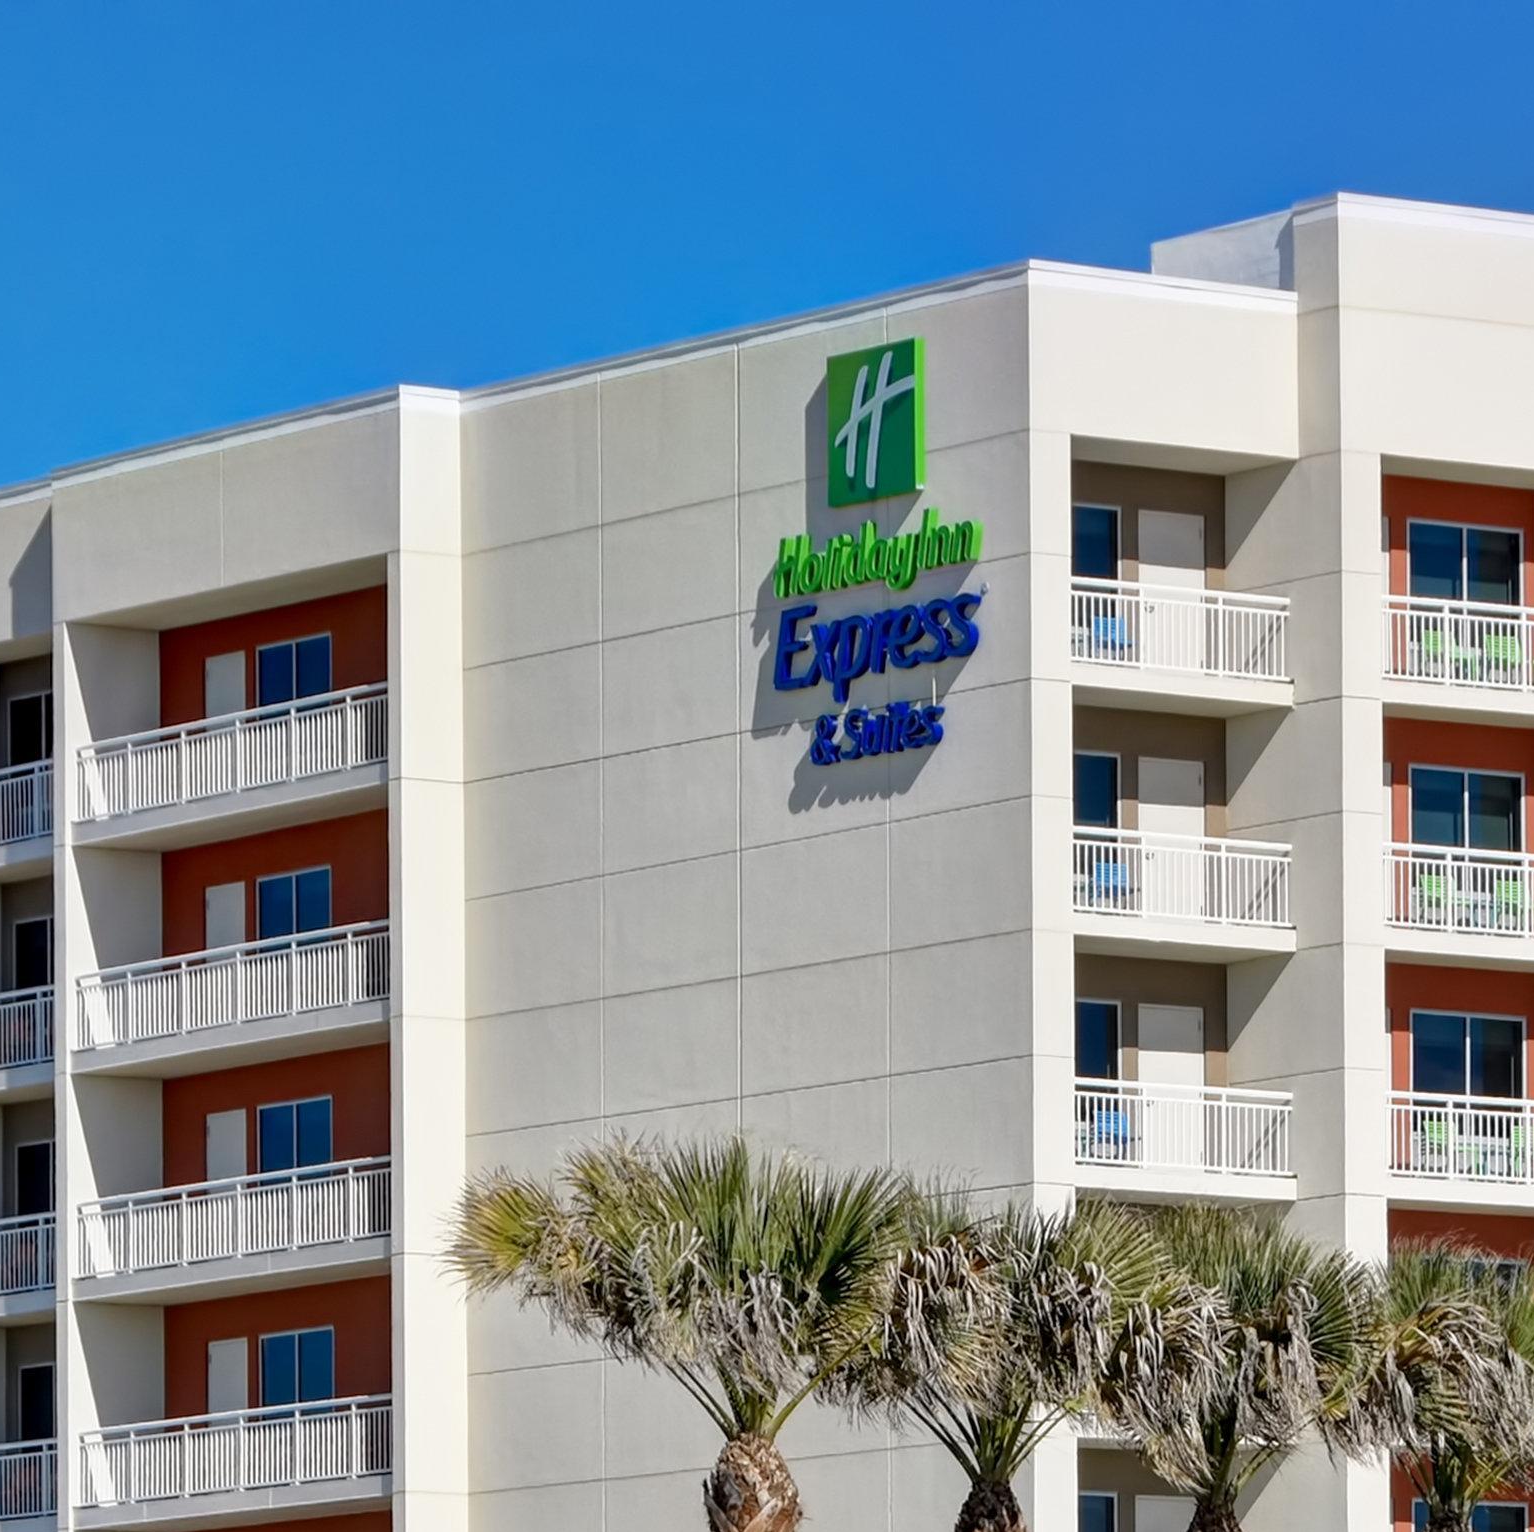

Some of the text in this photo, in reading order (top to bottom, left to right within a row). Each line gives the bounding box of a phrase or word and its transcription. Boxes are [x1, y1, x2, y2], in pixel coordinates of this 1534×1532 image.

[834, 350, 915, 489] H
[773, 507, 984, 598] Holiday Inn
[773, 593, 981, 703] Express
[809, 701, 945, 766] & Suites
